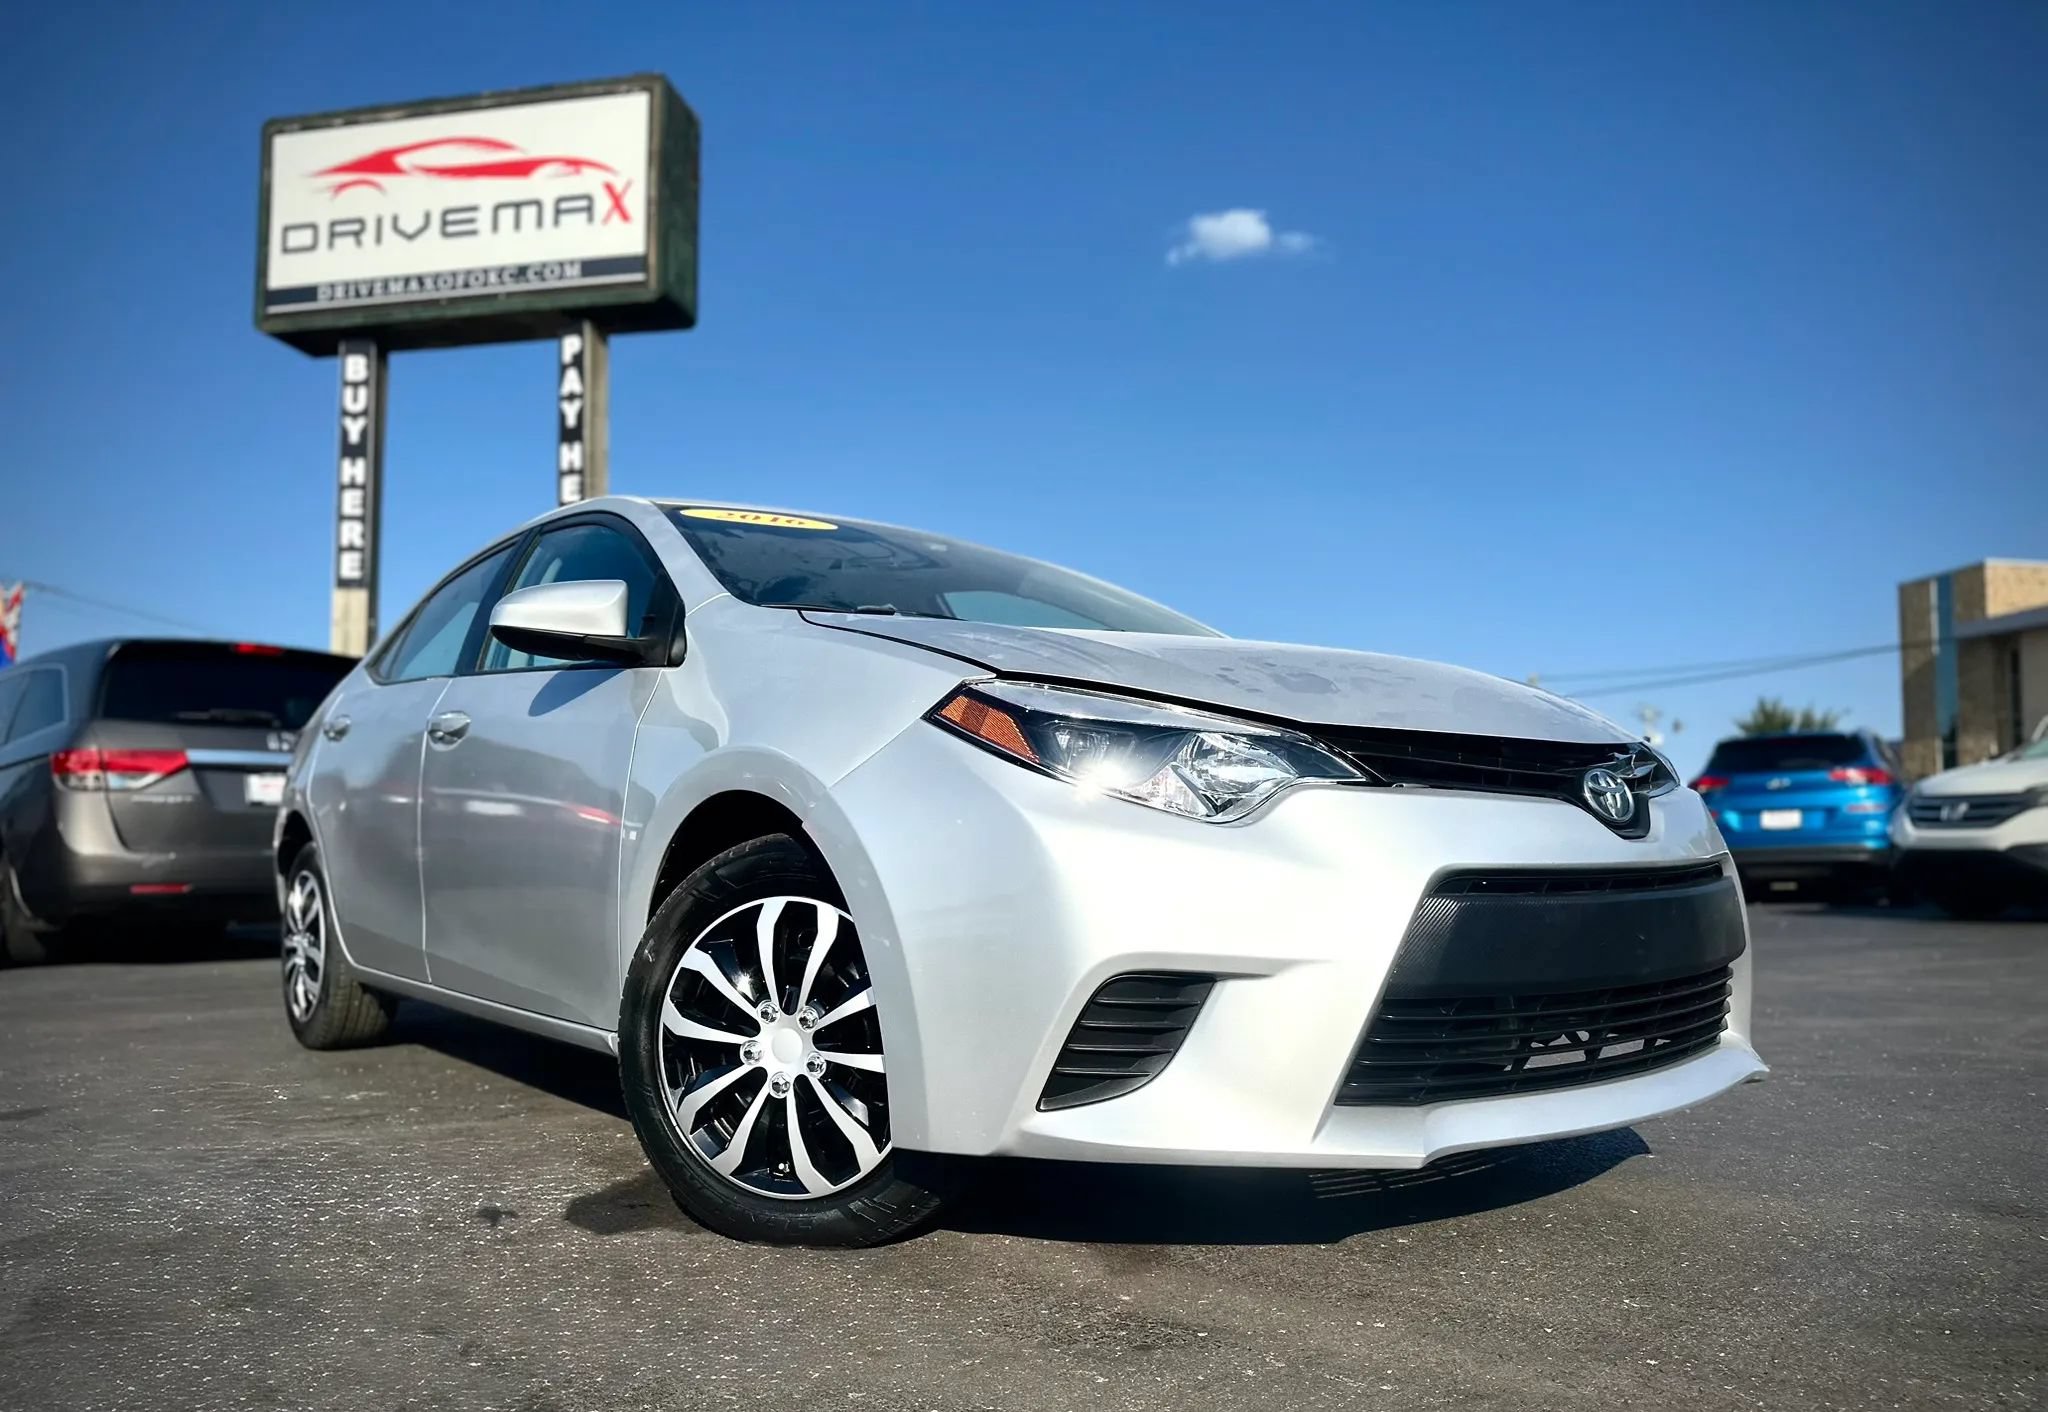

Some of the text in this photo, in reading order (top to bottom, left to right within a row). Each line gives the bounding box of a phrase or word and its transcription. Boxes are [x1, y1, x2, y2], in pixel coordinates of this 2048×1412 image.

[280, 178, 633, 255] DRIVEMAX
[559, 333, 583, 430] PAY
[339, 353, 368, 580] BUY HERE
